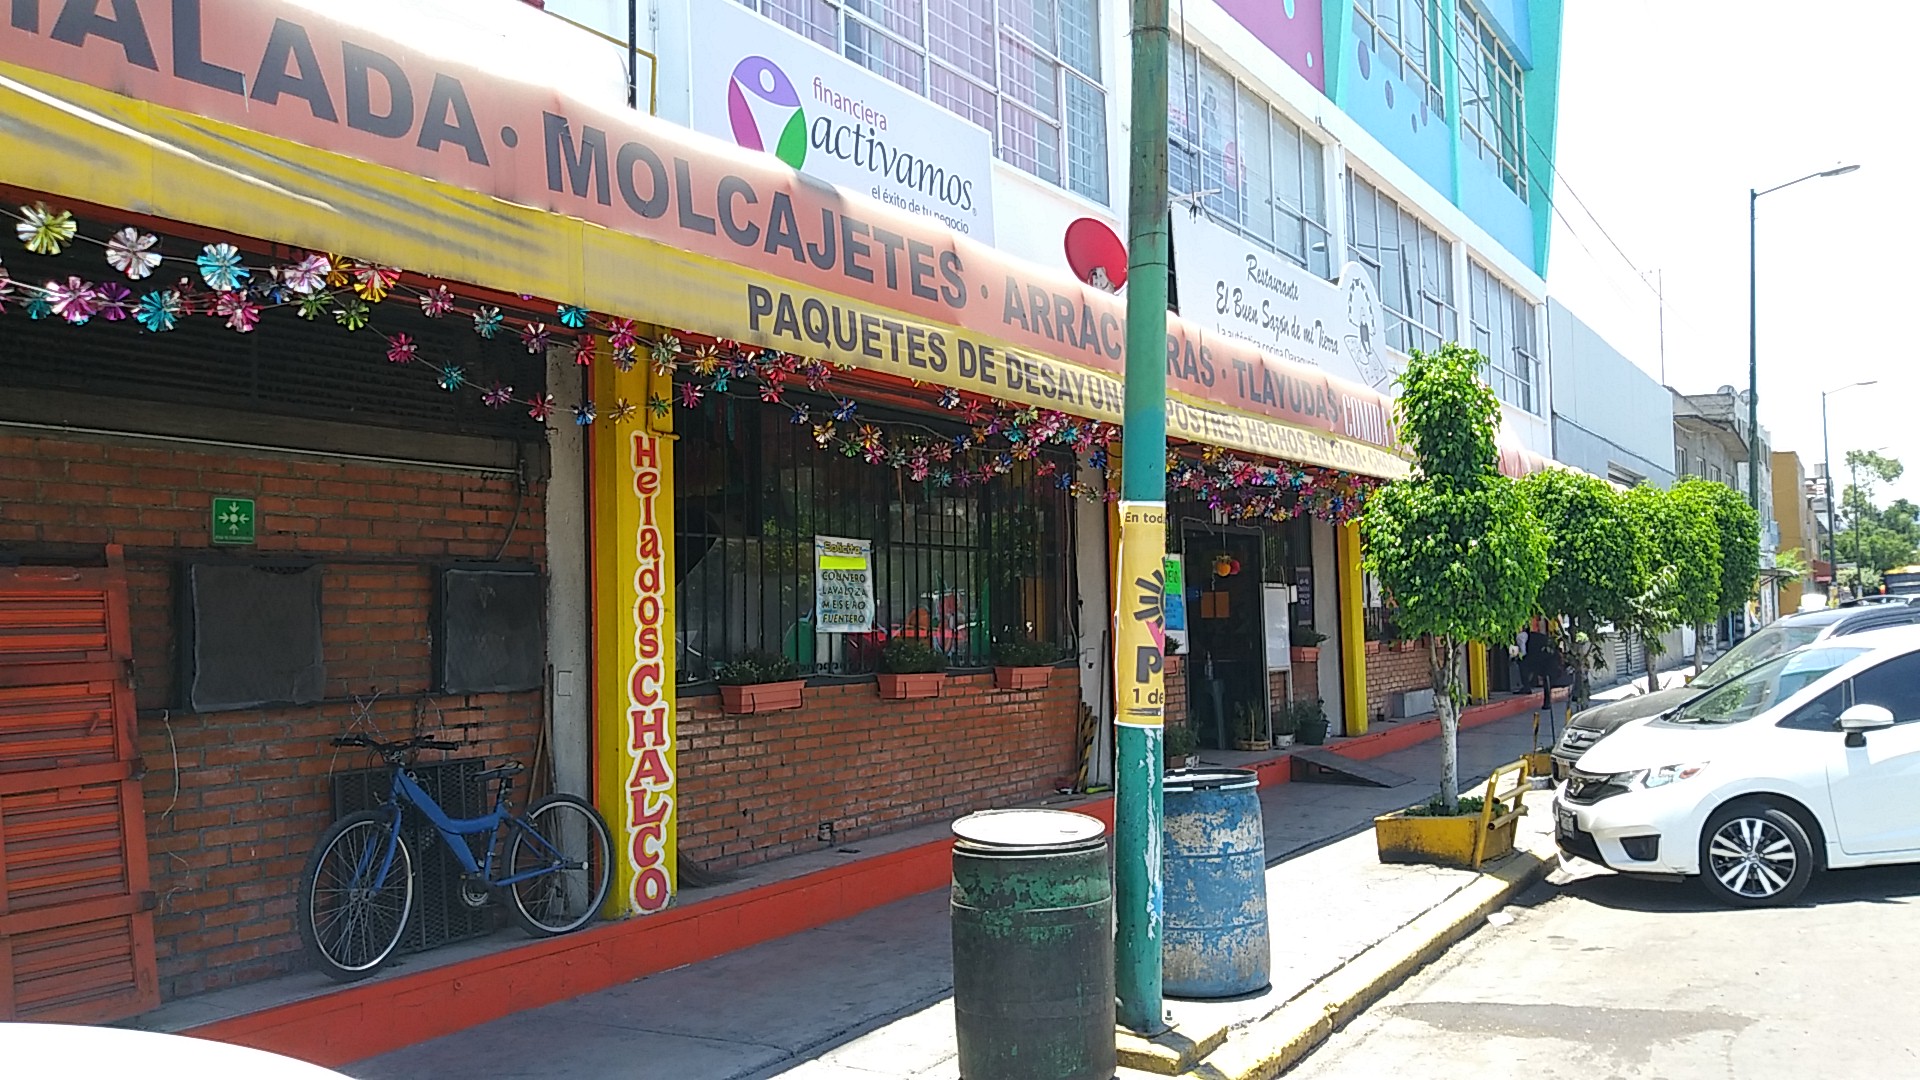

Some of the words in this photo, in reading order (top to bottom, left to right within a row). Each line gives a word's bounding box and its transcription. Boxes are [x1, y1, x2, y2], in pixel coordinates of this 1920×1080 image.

[812, 76, 887, 131] financiera
[811, 116, 973, 211] activamos
[11, 0, 489, 168] ALADA
[542, 110, 967, 309] MOLCAJETES
[1003, 276, 1215, 388] ARRACRAS
[1232, 358, 1338, 423] TLAYUDAS
[1342, 394, 1390, 448] COMIDA
[871, 184, 880, 200] el
[882, 188, 907, 210] éxito
[908, 198, 921, 215] de
[1245, 254, 1300, 301] Restaurante
[1216, 280, 1230, 315] El
[1232, 287, 1259, 325] Buen
[1291, 315, 1301, 341] de
[1315, 319, 1339, 355] Tierra
[747, 283, 948, 374] PAQUETES
[957, 338, 997, 384] DE
[1005, 354, 1125, 414] DESAYUN
[1166, 398, 1244, 443] POSTRES
[1245, 418, 1306, 458] HECHOS
[1310, 434, 1329, 462] EN
[1331, 442, 1365, 468] CASA
[1125, 511, 1139, 523] En
[1143, 512, 1165, 524] tod
[633, 434, 662, 660] Helados
[821, 600, 866, 610] MESERO
[822, 613, 866, 624] FUENTERO
[1132, 688, 1140, 704] 1
[630, 662, 670, 912] CHALCO
